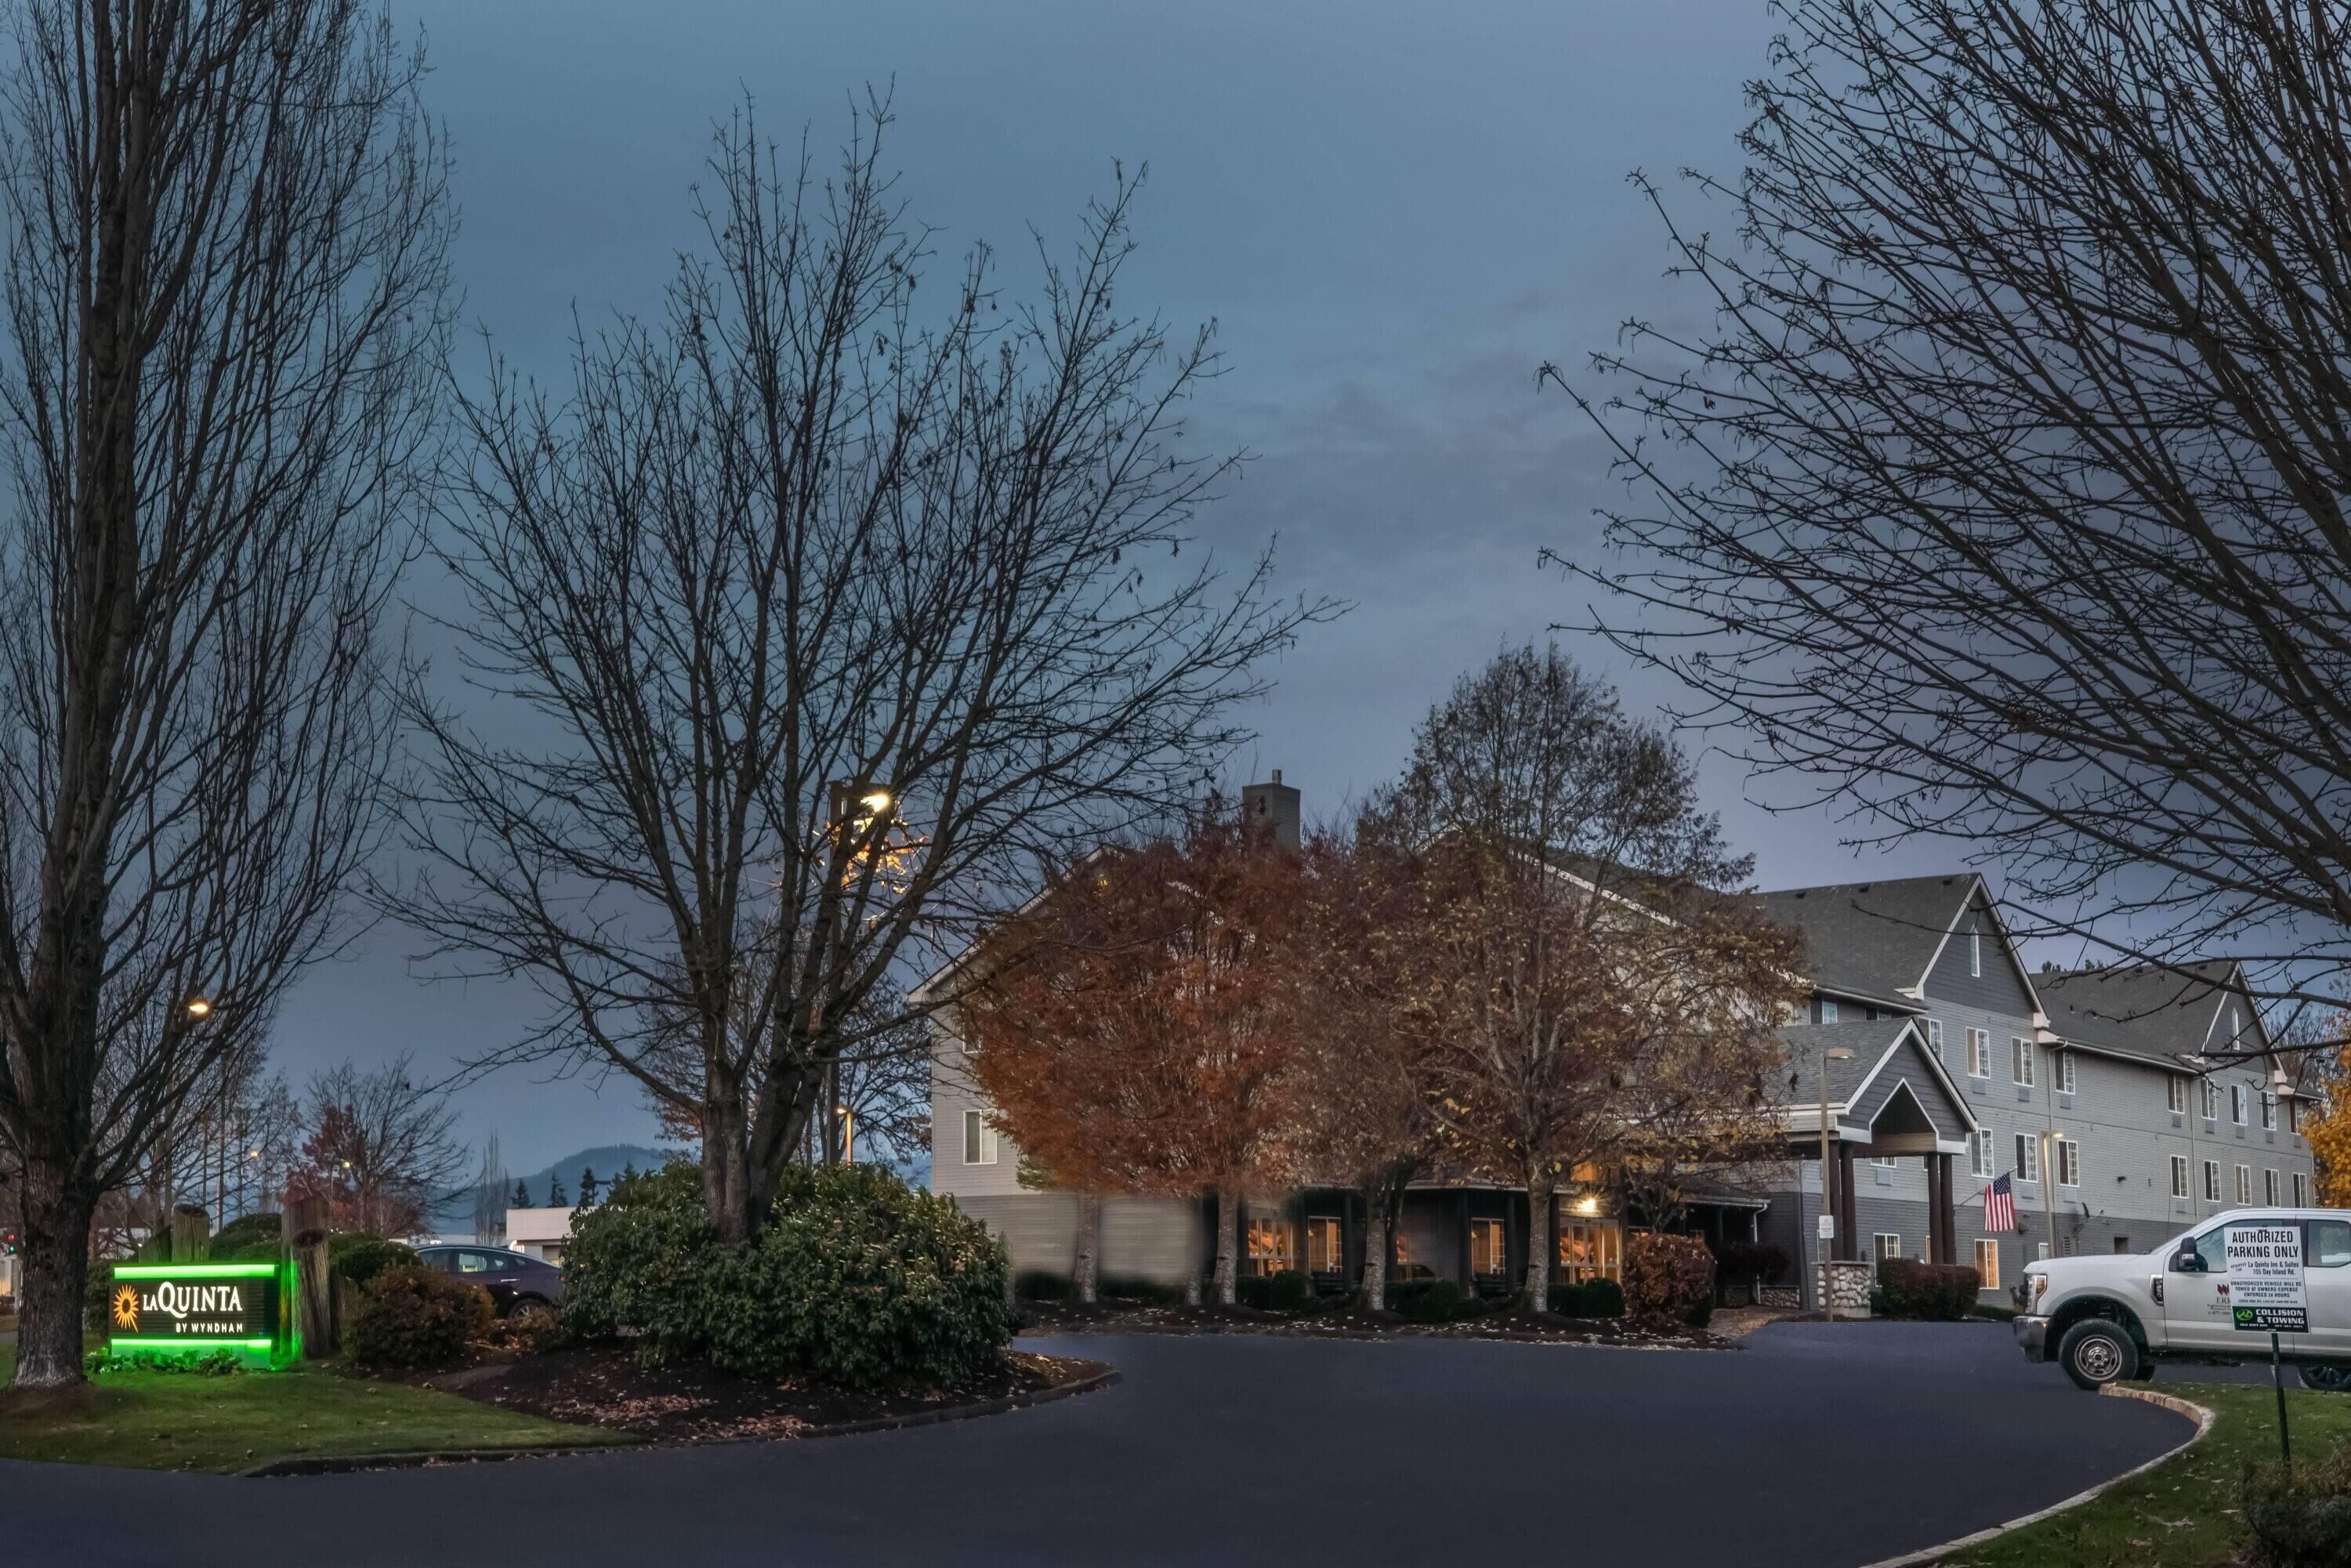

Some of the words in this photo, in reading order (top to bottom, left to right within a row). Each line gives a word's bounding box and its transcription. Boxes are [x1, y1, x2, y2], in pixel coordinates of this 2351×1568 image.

[2232, 1230, 2293, 1244] AUTHORIZED
[2227, 1246, 2270, 1258] PARKING
[2274, 1246, 2298, 1258] ONLY
[143, 1295, 158, 1311] LA
[158, 1281, 243, 1319] QUINTA
[176, 1323, 187, 1333] BY
[191, 1323, 243, 1333] WYNDHAM
